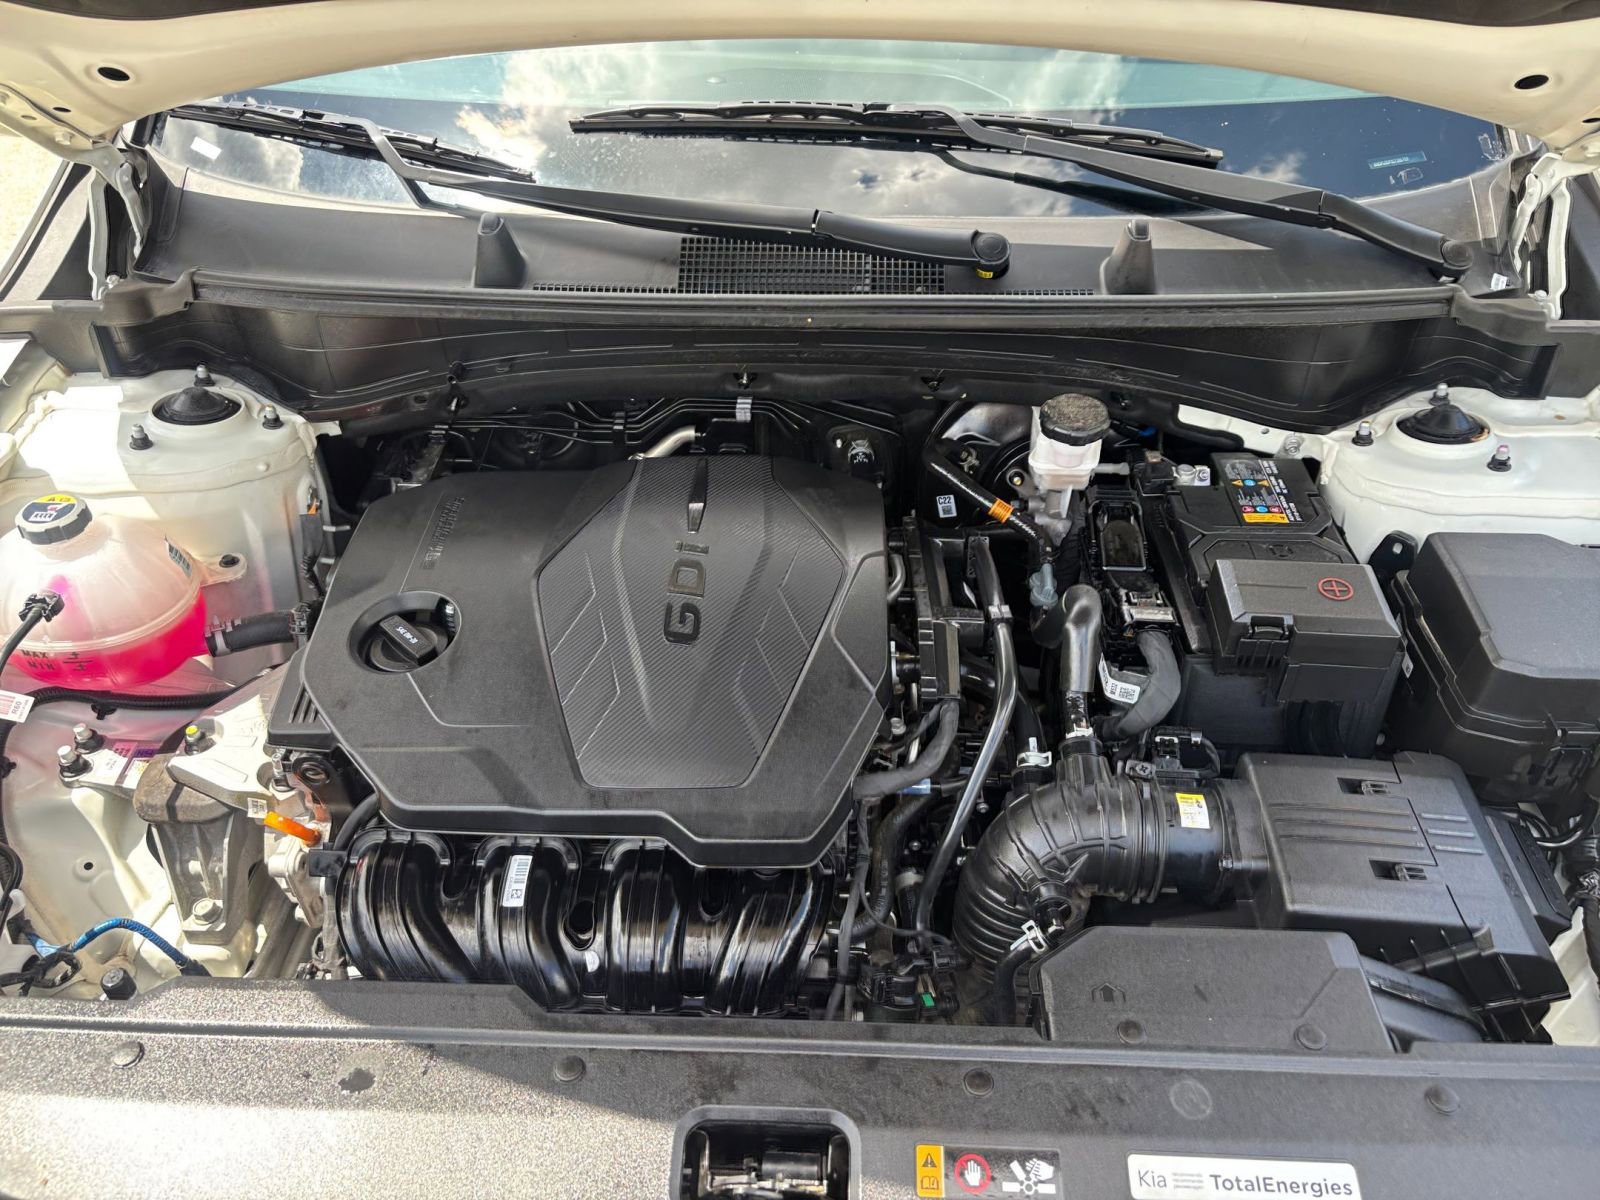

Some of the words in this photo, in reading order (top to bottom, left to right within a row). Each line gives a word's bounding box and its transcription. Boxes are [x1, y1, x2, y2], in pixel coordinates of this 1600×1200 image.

[938, 496, 952, 505] C22
[664, 541, 709, 645] GDi
[1138, 1169, 1167, 1188] Kia
[1209, 1174, 1353, 1198] TotalEnergies
